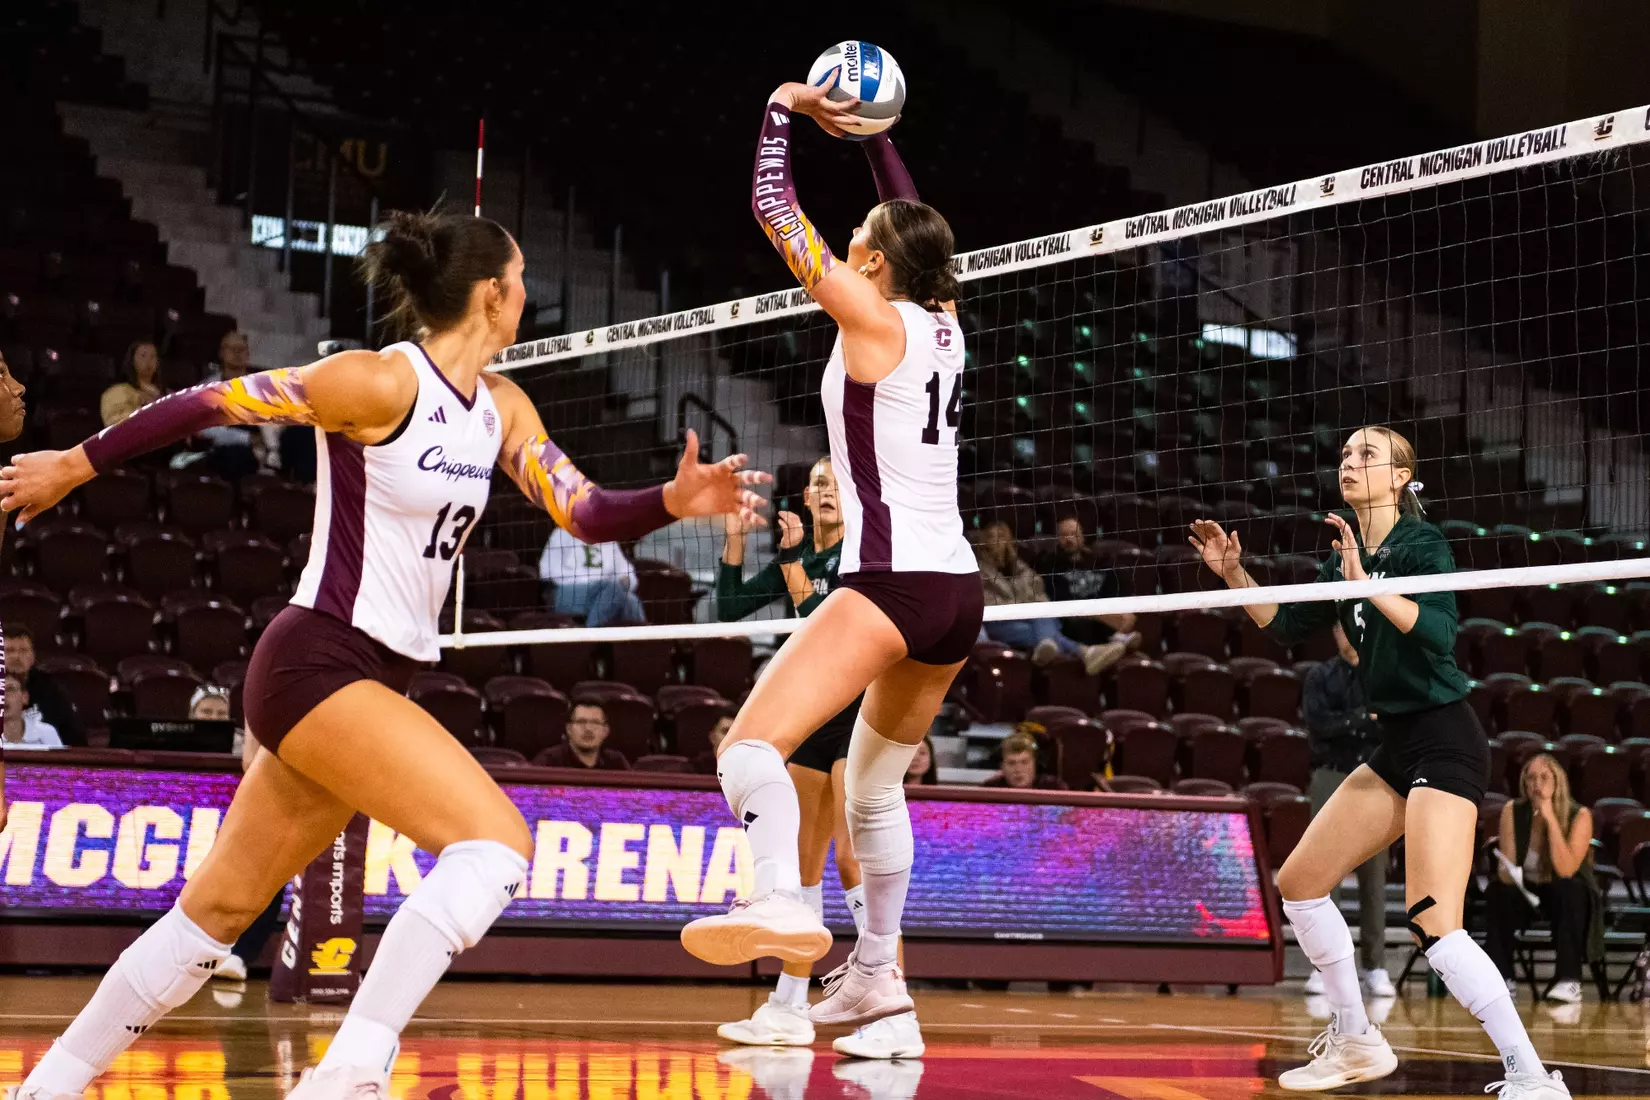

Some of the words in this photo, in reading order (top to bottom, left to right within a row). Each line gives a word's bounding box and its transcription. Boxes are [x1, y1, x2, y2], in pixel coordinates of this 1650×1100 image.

[1360, 160, 1414, 189] CENTRAL
[1418, 147, 1482, 177] MICHIGAN
[1485, 125, 1566, 165] VOLLEYBALL
[756, 137, 806, 241] CHIPPEWAS
[1125, 214, 1169, 239] CENTRAL
[1172, 201, 1225, 230] MICHIGAN
[1229, 184, 1296, 218] VOLLEYBALL
[967, 246, 1012, 272] MICHIGAN
[1014, 234, 1071, 263] VOLLEYBALL
[606, 323, 636, 343] CENTRAL
[637, 318, 672, 338] MICHIGAN
[673, 308, 715, 331] VOLLEYBALL
[755, 293, 787, 314] CENTRAL
[921, 371, 963, 446] 14
[422, 502, 475, 561] 13
[513, 820, 754, 903] RENA
[329, 862, 345, 925] imports
